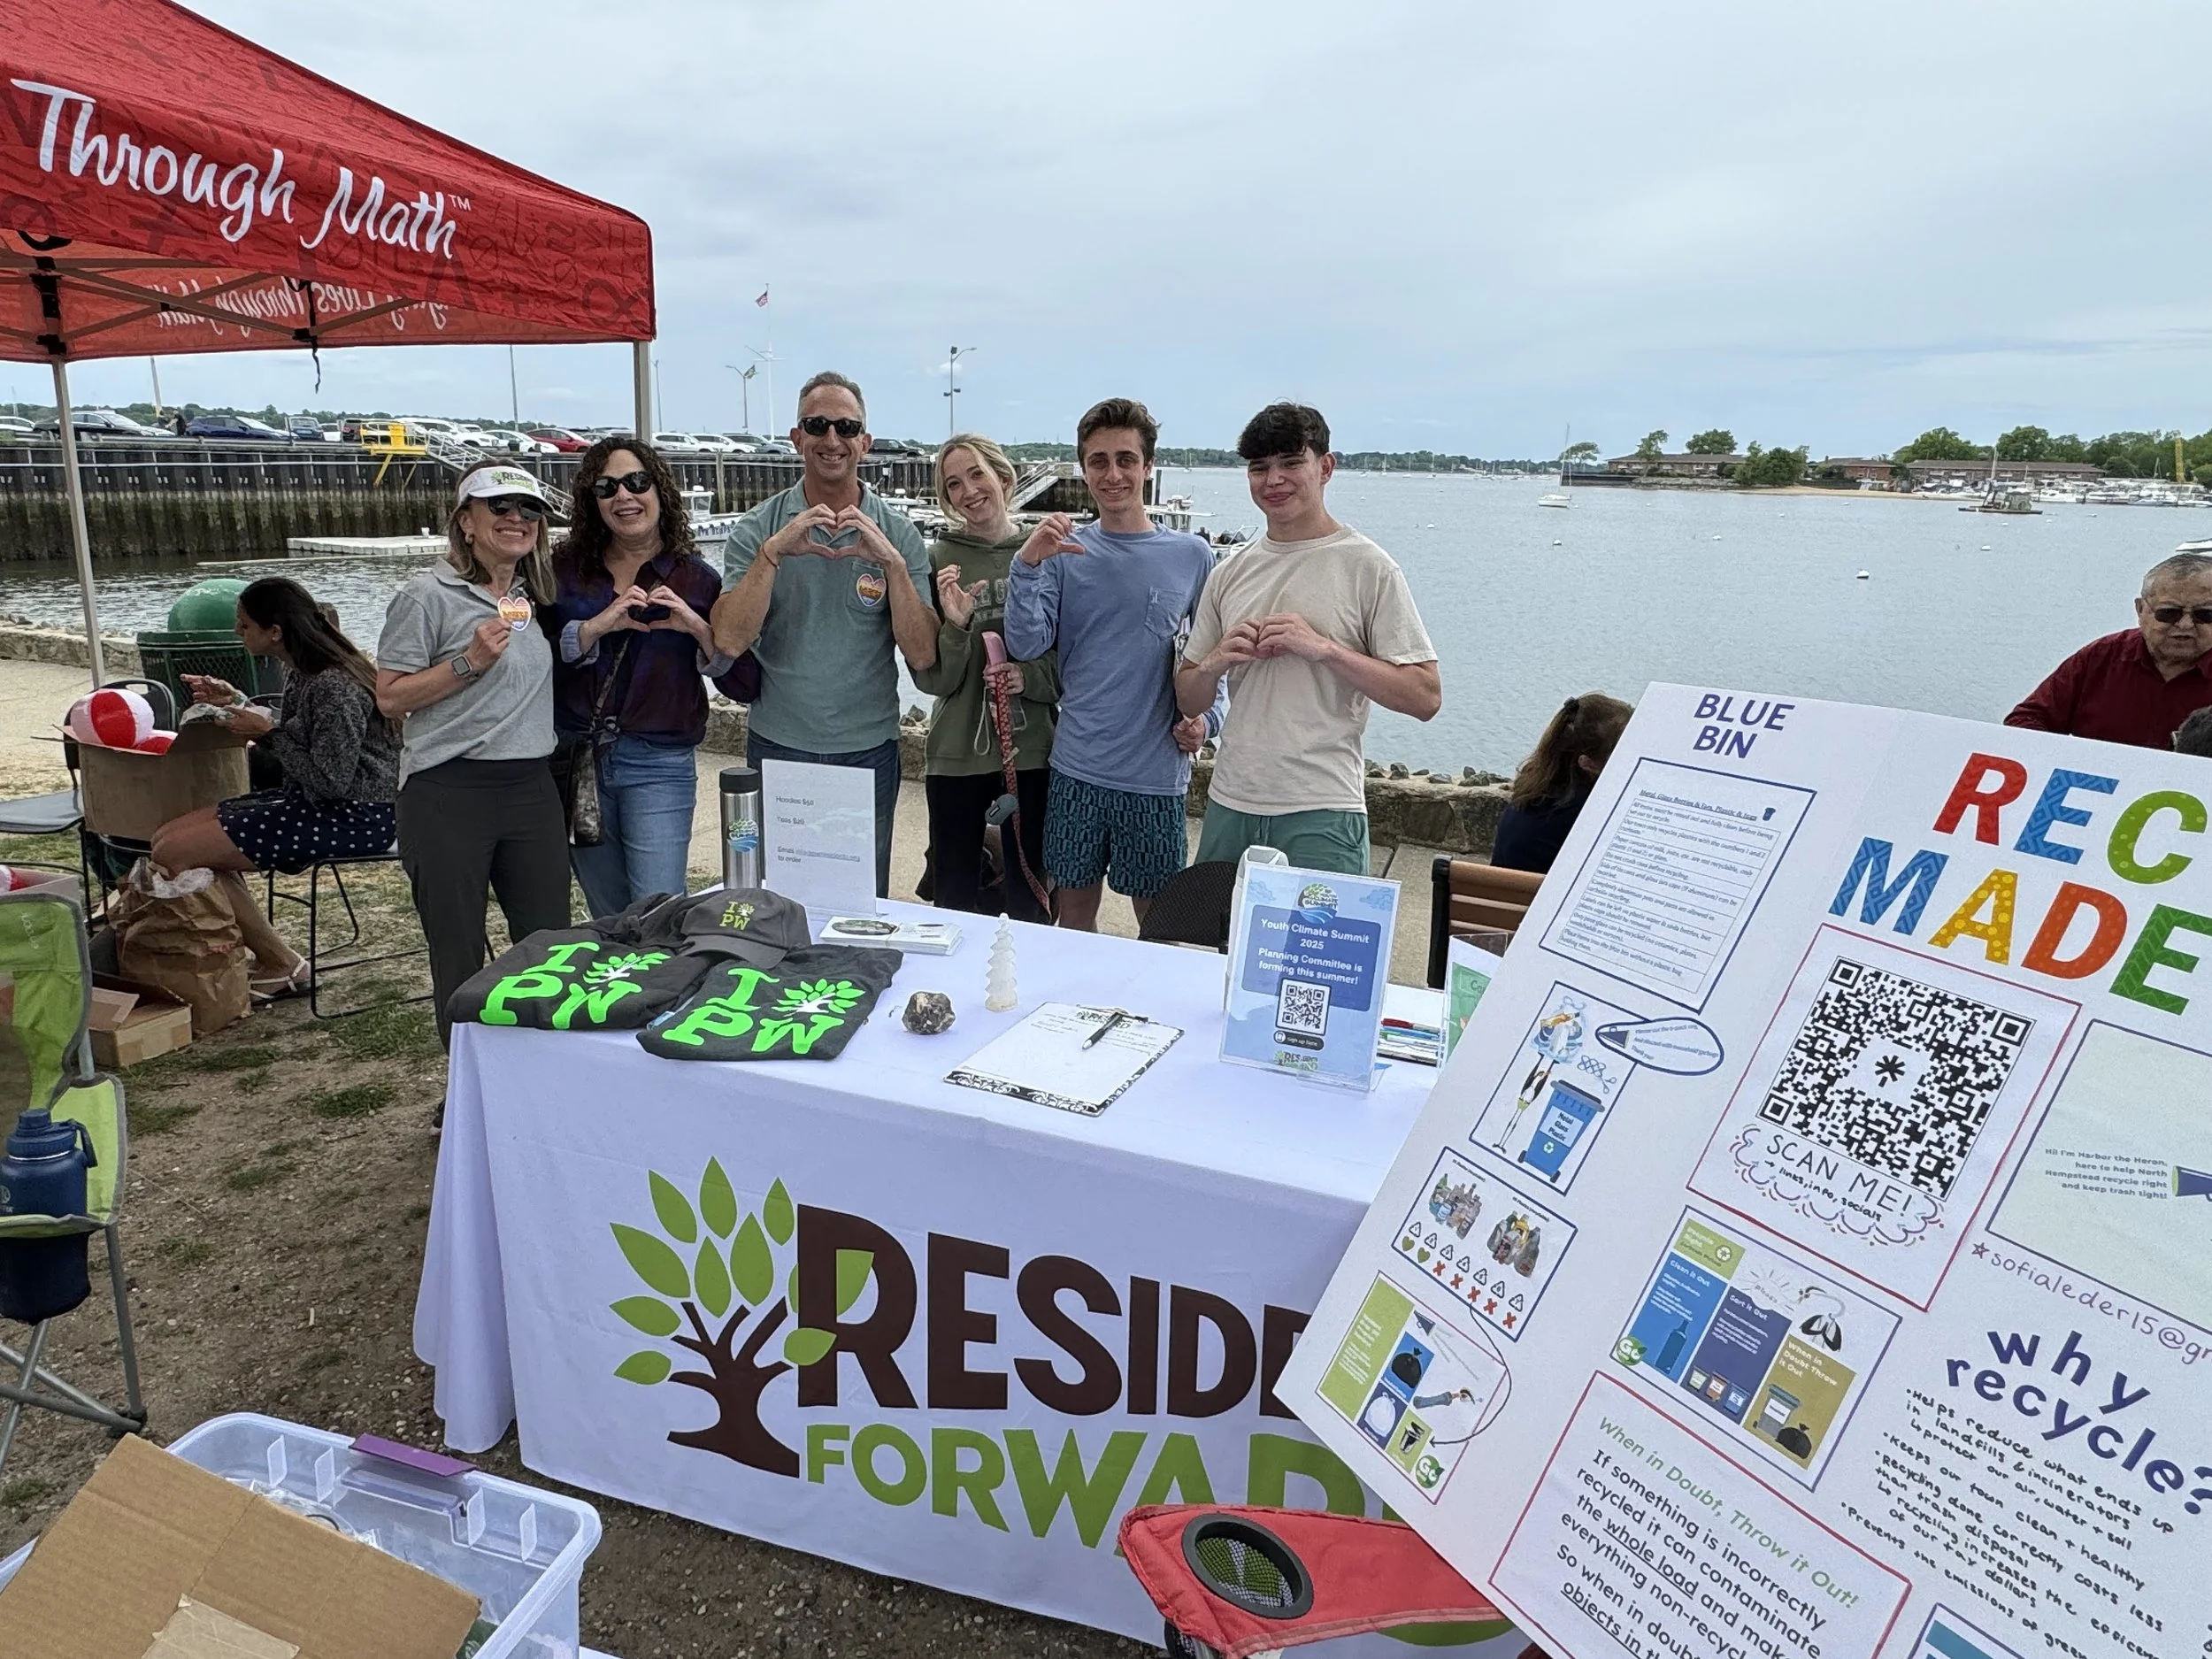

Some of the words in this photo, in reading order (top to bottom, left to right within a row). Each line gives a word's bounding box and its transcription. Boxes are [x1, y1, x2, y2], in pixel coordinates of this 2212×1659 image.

[10, 78, 296, 243] Through
[1693, 726, 1758, 759] BIN
[1694, 694, 1795, 731] BLUE
[1932, 752, 2209, 885] REC
[720, 913, 750, 930] PW
[726, 902, 737, 913] I
[1261, 918, 1288, 932] Youth
[1291, 924, 1328, 938] Climate
[1331, 930, 1370, 944] Summit
[1300, 938, 1324, 949] 2025
[1828, 836, 2212, 1016] MADE
[522, 941, 600, 974] I
[707, 968, 780, 1011] I
[1258, 948, 1299, 964] Planning
[1301, 954, 1351, 971] Committee
[1354, 964, 1363, 972] is
[1258, 961, 1294, 977] forming
[1297, 966, 1314, 979] this
[1316, 972, 1358, 985] summer!
[479, 973, 641, 1030] PW
[662, 1007, 844, 1054] PW
[1767, 1134, 1839, 1180] SCAN
[1848, 1172, 1912, 1217] ME!
[2045, 1169, 2100, 1181] Hempstead
[2102, 1176, 2139, 1186] recycle
[2141, 1179, 2168, 1188] right
[2078, 1152, 2111, 1161] Harbor
[2082, 1184, 2107, 1194] keep
[2109, 1187, 2135, 1196] trash
[2113, 1165, 2135, 1175] help
[2138, 1168, 2168, 1177] North
[1841, 1197, 1881, 1222] socials
[1782, 1348, 1811, 1371] Doubt
[1809, 1364, 1839, 1387] Throw
[1786, 1340, 1811, 1359] When
[1809, 1354, 1823, 1366] in
[1786, 1363, 1804, 1379] Out
[1986, 1330, 2151, 1415] why
[1907, 1400, 1920, 1416] in
[1936, 1414, 2005, 1463] landfills
[2028, 1468, 2130, 1530] incinerators
[1913, 1390, 1955, 1418] Helps
[1966, 1418, 2033, 1459] reduce
[2044, 1460, 2087, 1486] what
[2094, 1486, 2142, 1516] ends
[2153, 1517, 2174, 1533] up
[1946, 1358, 2212, 1516] recycle?
[1600, 1417, 1644, 1457] When
[1646, 1451, 1663, 1471] in
[1666, 1466, 1723, 1517] Doubt,
[1730, 1510, 1790, 1558] Throw
[1790, 1554, 1809, 1572] it
[1811, 1571, 1859, 1608] Out!
[1875, 1467, 1907, 1491] than
[1917, 1492, 1956, 1522] trash
[1965, 1525, 2028, 1568] disposal
[1923, 1429, 1978, 1461] protect
[1987, 1465, 2008, 1479] our
[2043, 1499, 2088, 1526] water
[2108, 1532, 2131, 1550] soil
[1562, 1514, 1655, 1589] everything
[1577, 1469, 1646, 1525] recycled
[1647, 1517, 1661, 1536] it
[1663, 1534, 1695, 1564] can
[1690, 1562, 1820, 1659] contaminate
[1593, 1449, 1611, 1469] If
[1611, 1466, 1699, 1539] something
[1702, 1528, 1718, 1550] is
[1715, 1543, 1826, 1632] incorrectly
[1889, 1509, 1905, 1522] of
[1913, 1525, 1938, 1542] our
[1943, 1541, 1977, 1566] tax
[1985, 1570, 2036, 1608] dollars
[1897, 1497, 1958, 1544] recycling
[1964, 1538, 2037, 1591] increases
[2046, 1589, 2078, 1616] the
[1939, 1467, 1962, 1481] our
[1970, 1483, 2003, 1509] town
[2016, 1511, 2057, 1540] clean
[2081, 1544, 2145, 1592] healthy
[1947, 1497, 1984, 1524] done
[1993, 1525, 2063, 1573] correctly
[2074, 1573, 2118, 1605] costs
[2130, 1604, 2162, 1632] less
[1557, 1544, 1577, 1567] So
[1581, 1564, 1624, 1608] when
[1627, 1600, 1643, 1624] in
[1647, 1622, 1701, 1659] doub
[1577, 1494, 1602, 1521] the
[1602, 1518, 1654, 1564] whole
[1654, 1555, 1699, 1598] load
[1701, 1594, 1740, 1628] and
[1740, 1624, 1789, 1659] mak
[1914, 1550, 1936, 1569] the
[1945, 1569, 2014, 1618] emissions
[2023, 1618, 2038, 1631] of
[1562, 1582, 1622, 1638] objects
[1621, 1629, 1640, 1656] in
